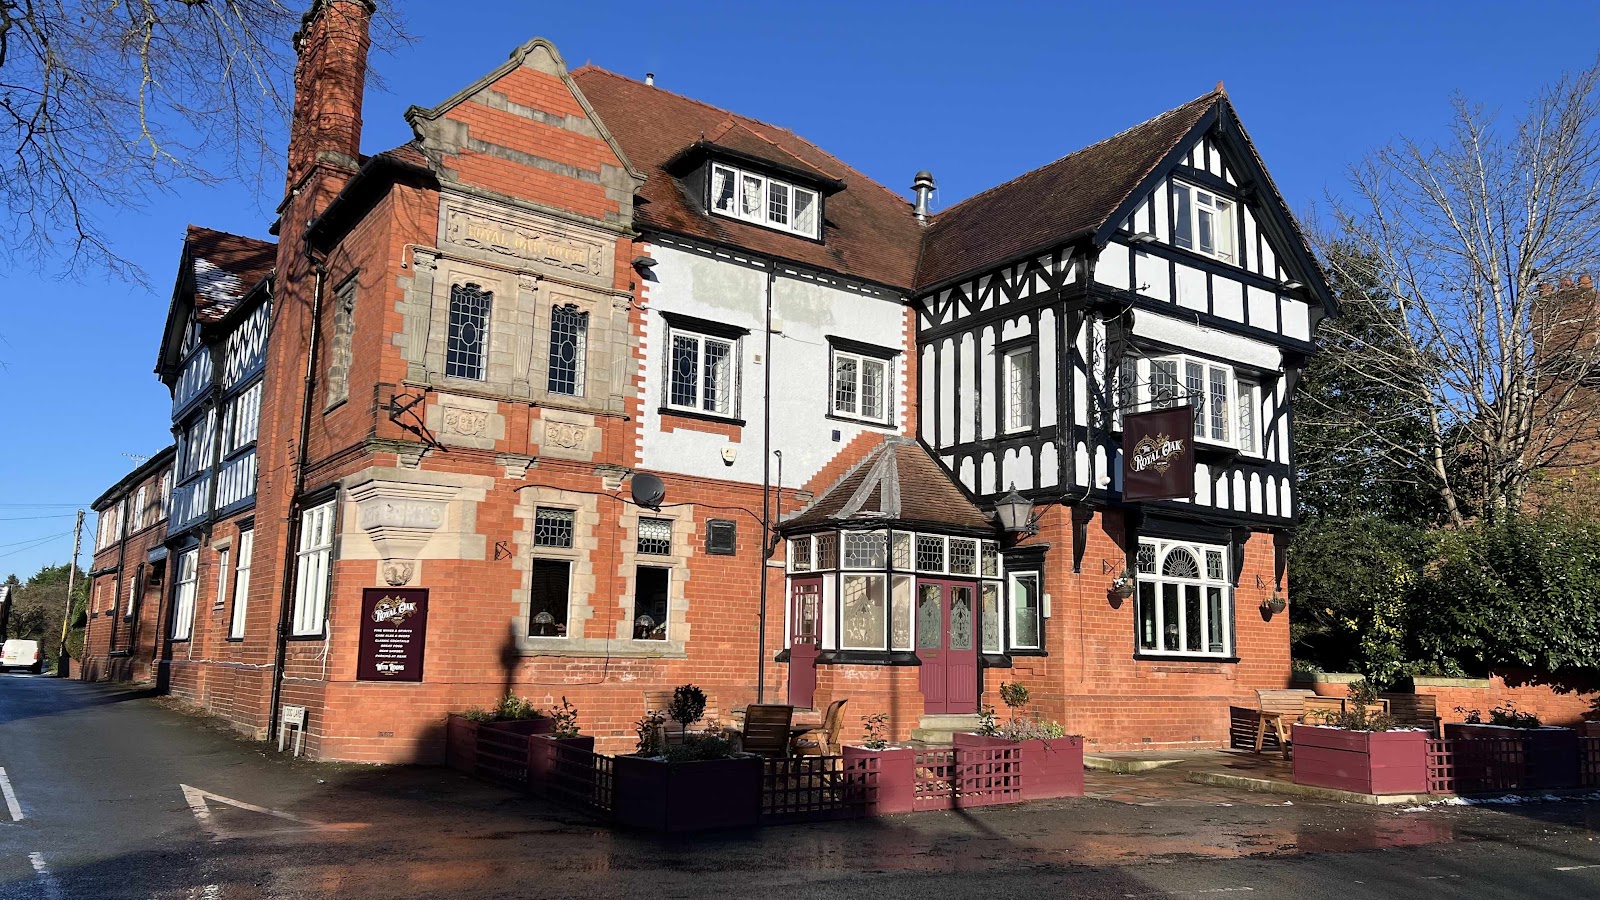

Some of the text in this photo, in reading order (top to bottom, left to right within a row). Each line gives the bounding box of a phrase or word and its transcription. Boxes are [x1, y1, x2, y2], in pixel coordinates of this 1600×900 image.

[468, 224, 585, 262] ROYAL OAK HOTEL
[1134, 440, 1182, 472] ROYAL OAK
[375, 602, 415, 623] ROYAL OAK
